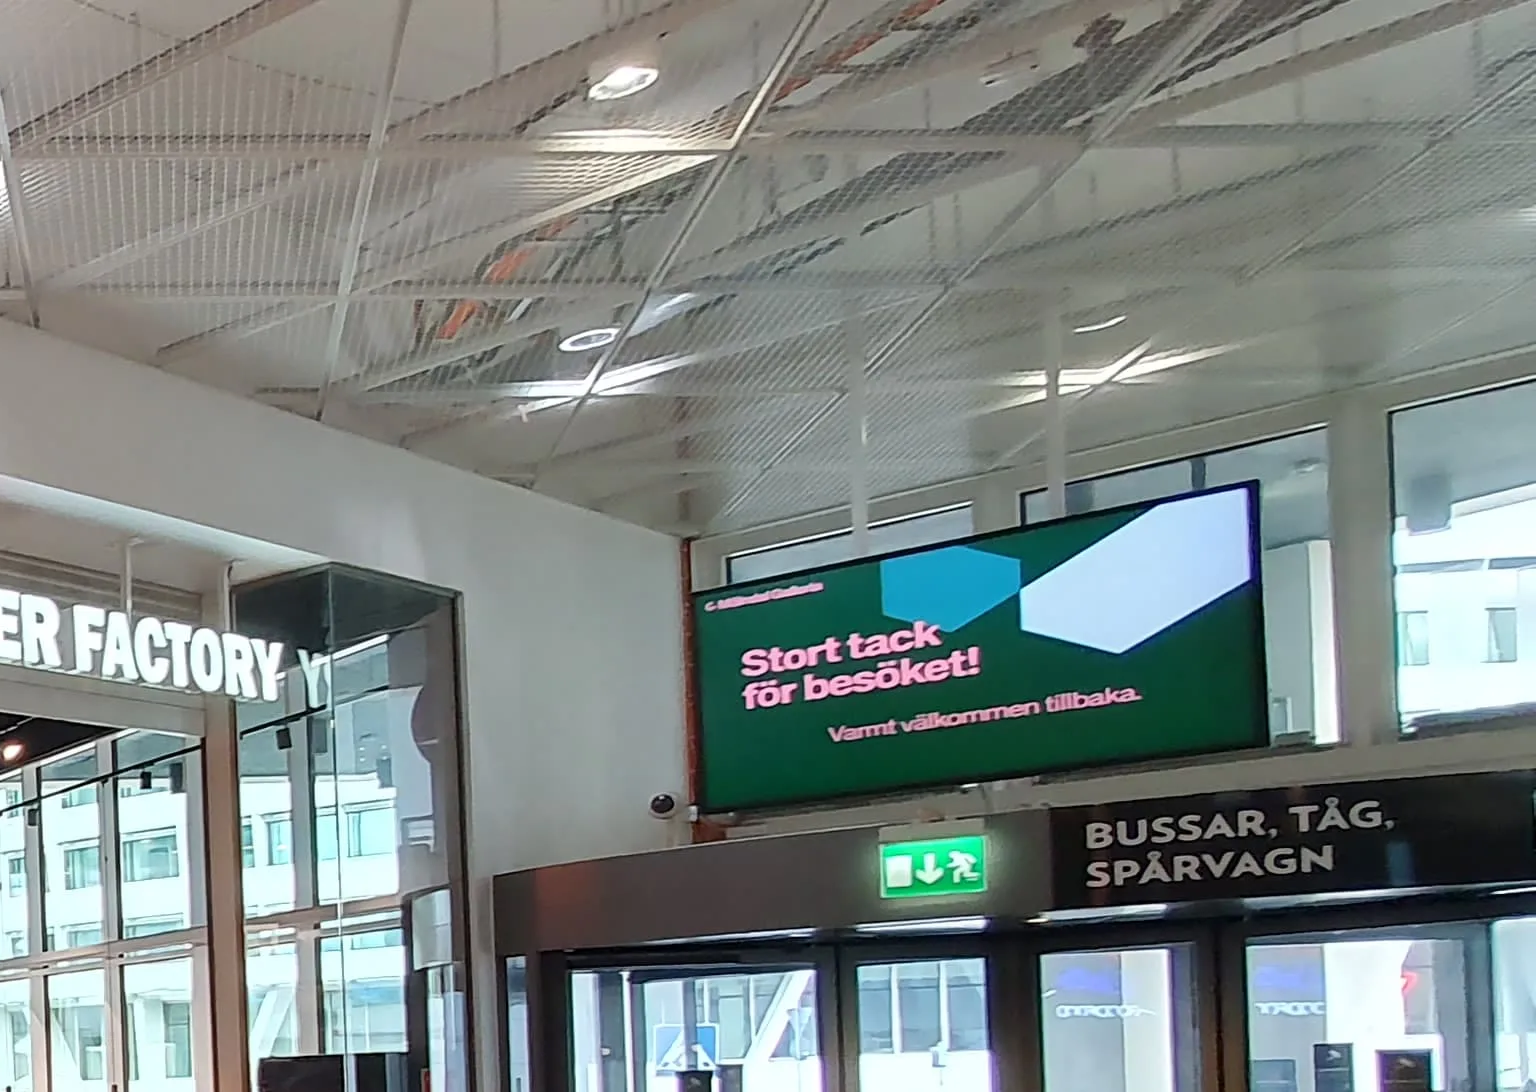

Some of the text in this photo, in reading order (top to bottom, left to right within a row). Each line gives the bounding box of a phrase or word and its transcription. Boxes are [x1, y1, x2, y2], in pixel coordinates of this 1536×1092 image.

[73, 604, 284, 702] FACTORY
[741, 620, 944, 677] Stort tack
[741, 646, 981, 709] för besöket!
[827, 685, 1143, 743] Varmt välkommen tillbaka.
[1084, 797, 1395, 850] BUSSAR, TÅG,
[1084, 844, 1335, 888] SPÅRVAGN
